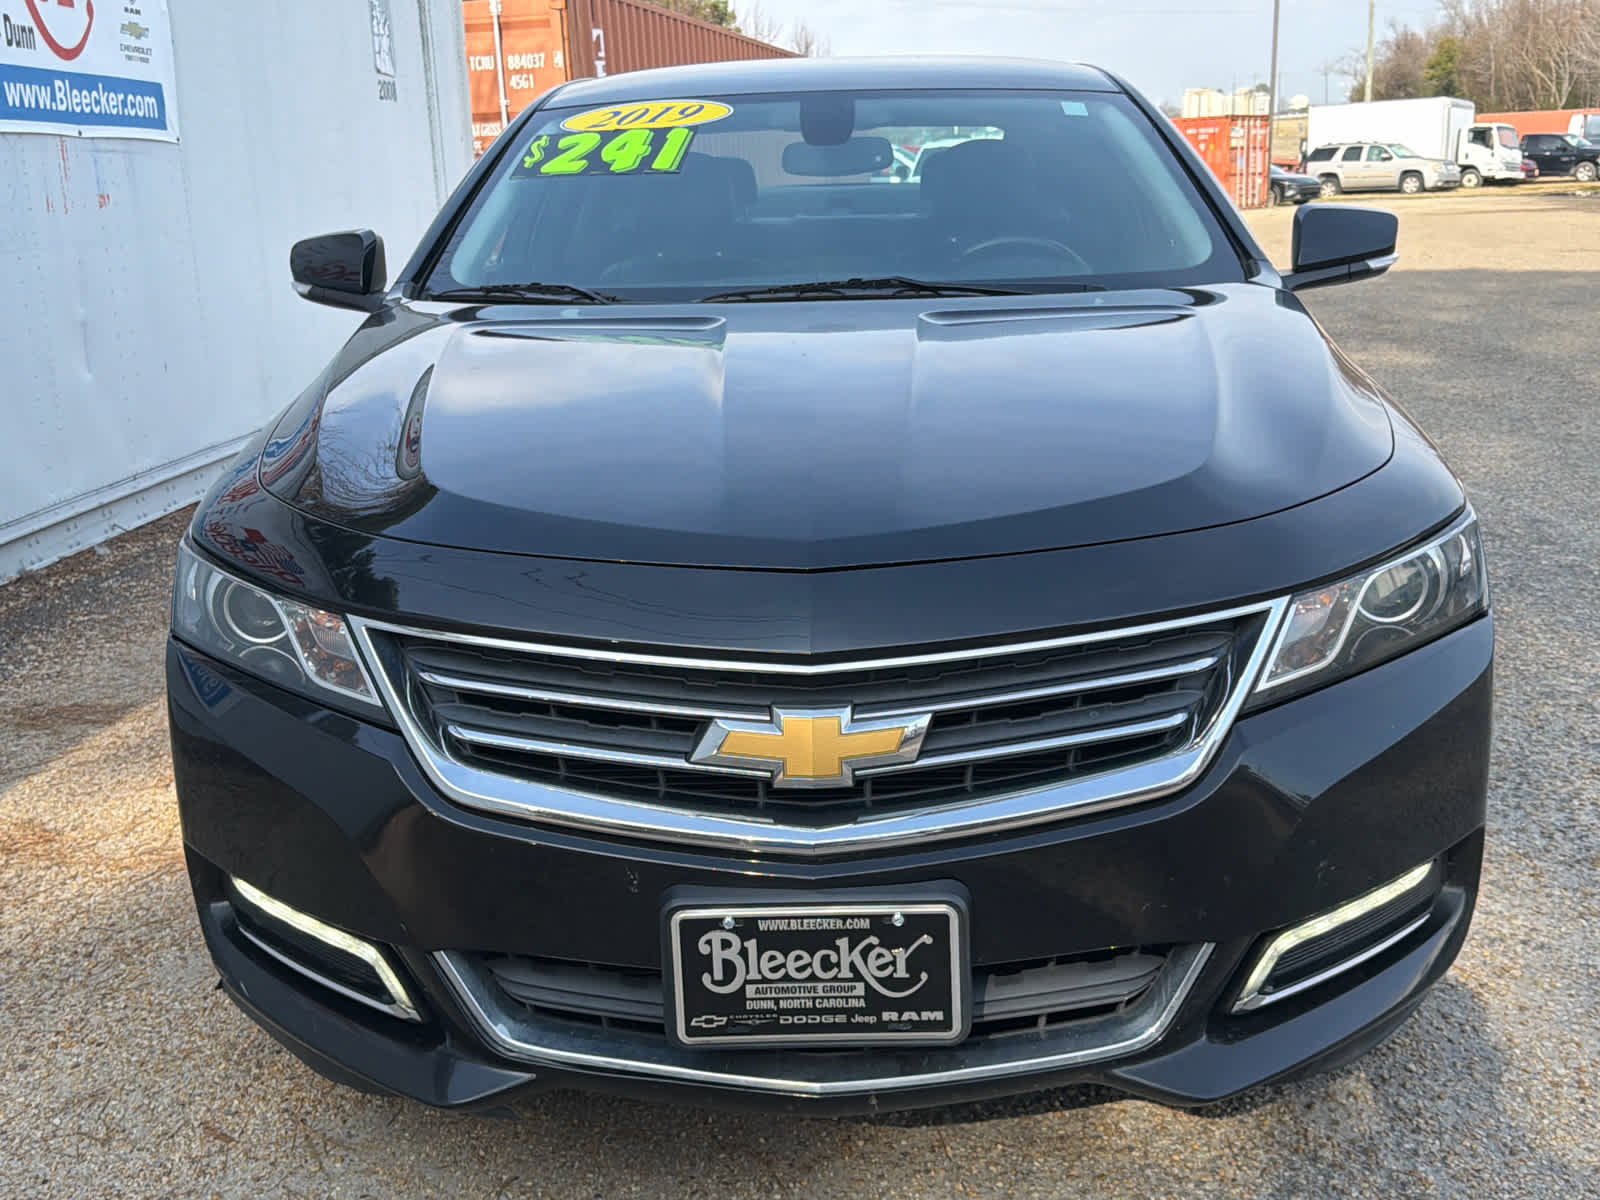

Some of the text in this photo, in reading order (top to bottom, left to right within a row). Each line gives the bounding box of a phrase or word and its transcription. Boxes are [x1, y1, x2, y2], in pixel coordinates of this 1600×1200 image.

[3, 13, 36, 50] Dunn
[509, 73, 535, 89] 45G1
[3, 79, 158, 119] www.Bleecker.com
[587, 104, 705, 129] 2019
[757, 918, 871, 931] WWW.BLEECKER.COM
[754, 984, 857, 996] AUTOMOTIVE GROUP
[746, 998, 866, 1011] DUNN, NORTH CAROLINA
[779, 1014, 847, 1025] DODGE
[850, 1014, 877, 1025] Jeep
[881, 1010, 944, 1021] RAM
